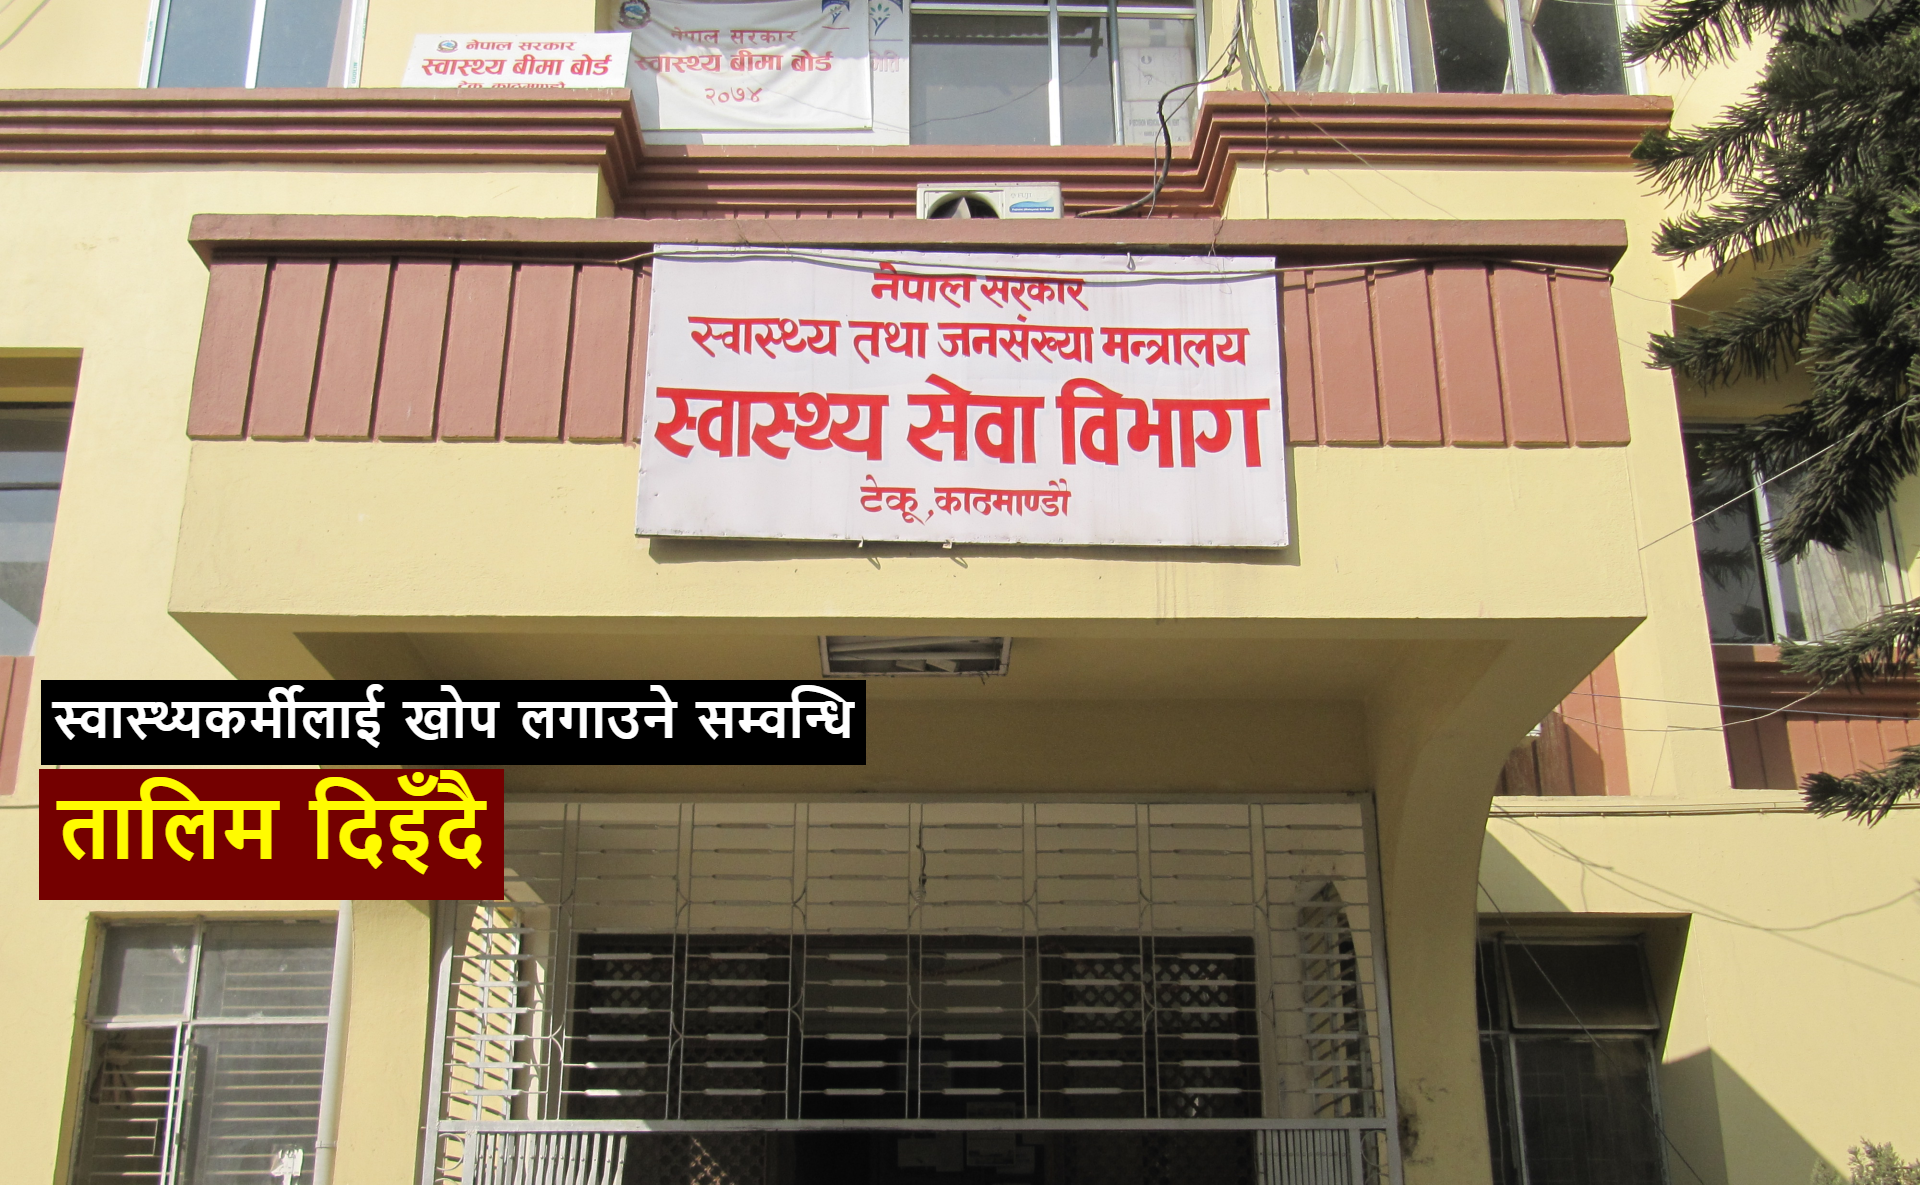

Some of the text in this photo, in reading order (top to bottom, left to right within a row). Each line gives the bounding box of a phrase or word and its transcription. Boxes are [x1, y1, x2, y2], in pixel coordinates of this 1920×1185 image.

[465, 39, 577, 51] नेपाल सरकार
[670, 26, 798, 45] नेपाल सरकार
[422, 53, 613, 76] स्वास्थ्य बीमा बोर्ड
[634, 49, 834, 73] स्वास्थ्य बीमा बोर्ड
[704, 86, 763, 104] २०७४
[871, 261, 1089, 312] नेपाल सरकार
[687, 314, 1251, 368] स्वास्थ्य तथा जनसंख्या मन्त्रालय
[654, 373, 1271, 469] स्वास्थ्य सेवा विभाग
